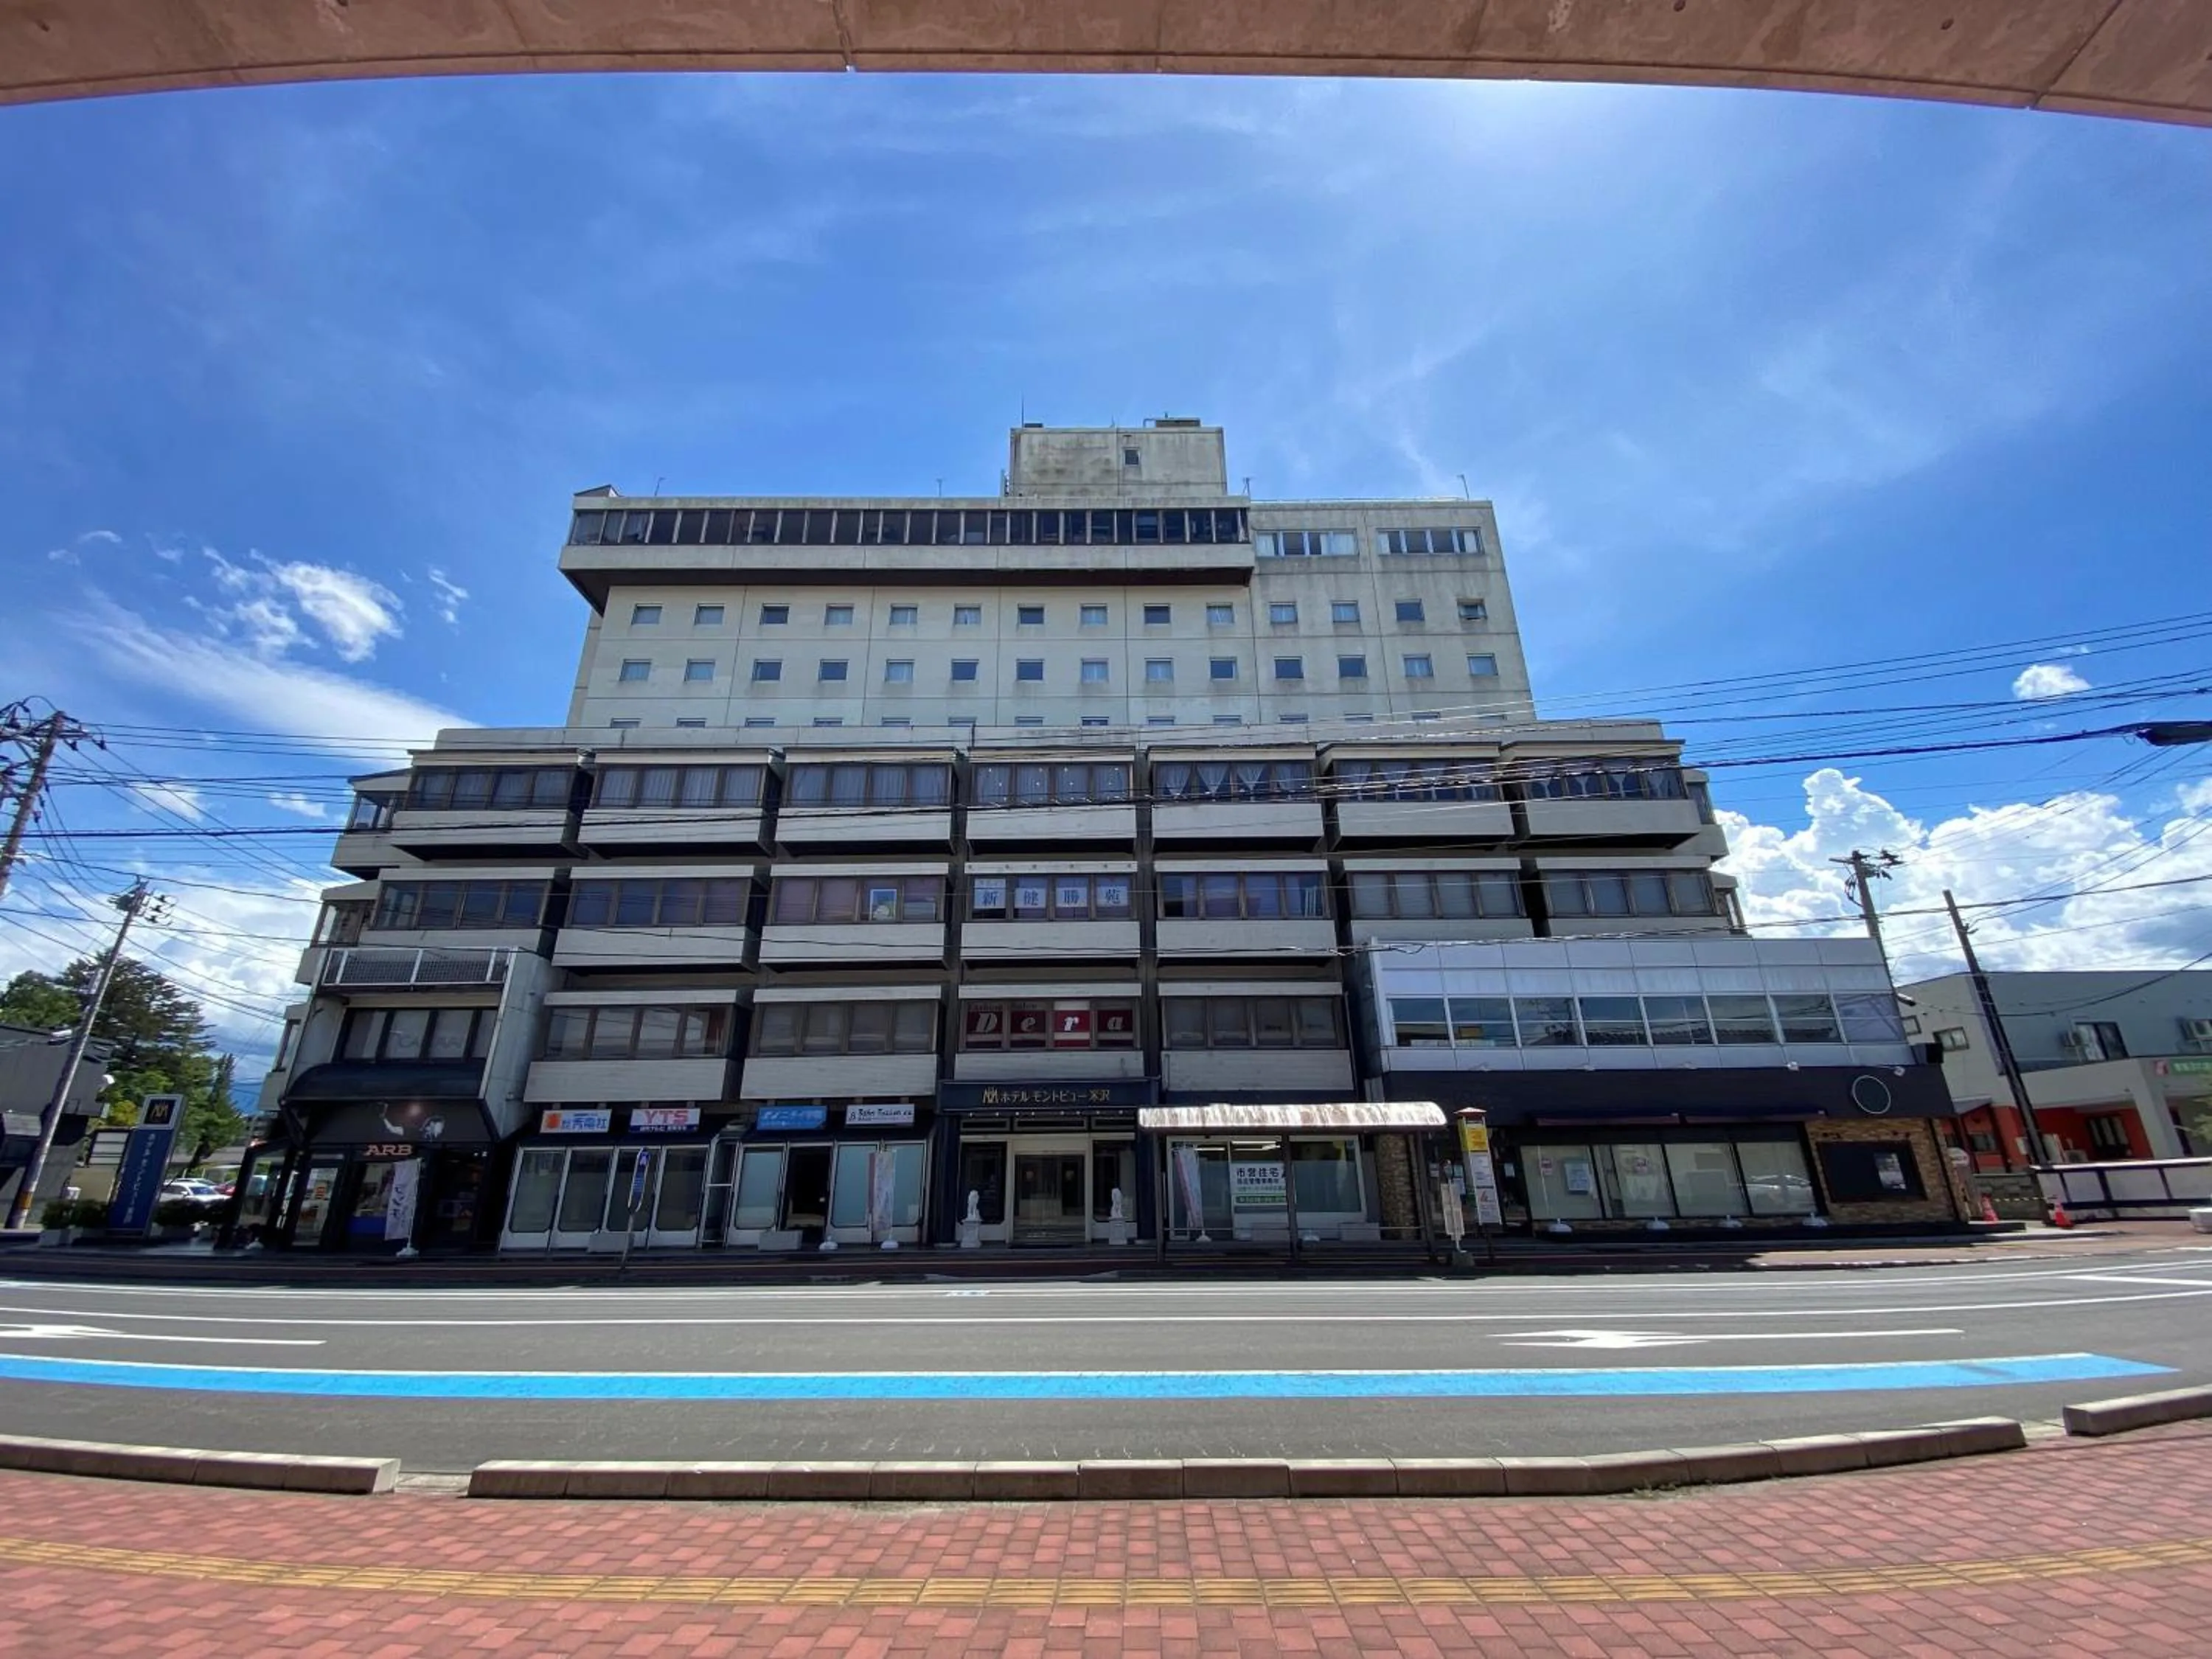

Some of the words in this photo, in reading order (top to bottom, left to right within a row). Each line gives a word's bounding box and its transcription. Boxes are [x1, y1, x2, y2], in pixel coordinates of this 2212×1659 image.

[975, 1012, 1124, 1033] Dera
[644, 1110, 689, 1124] YTS
[364, 1144, 413, 1156] ARB
